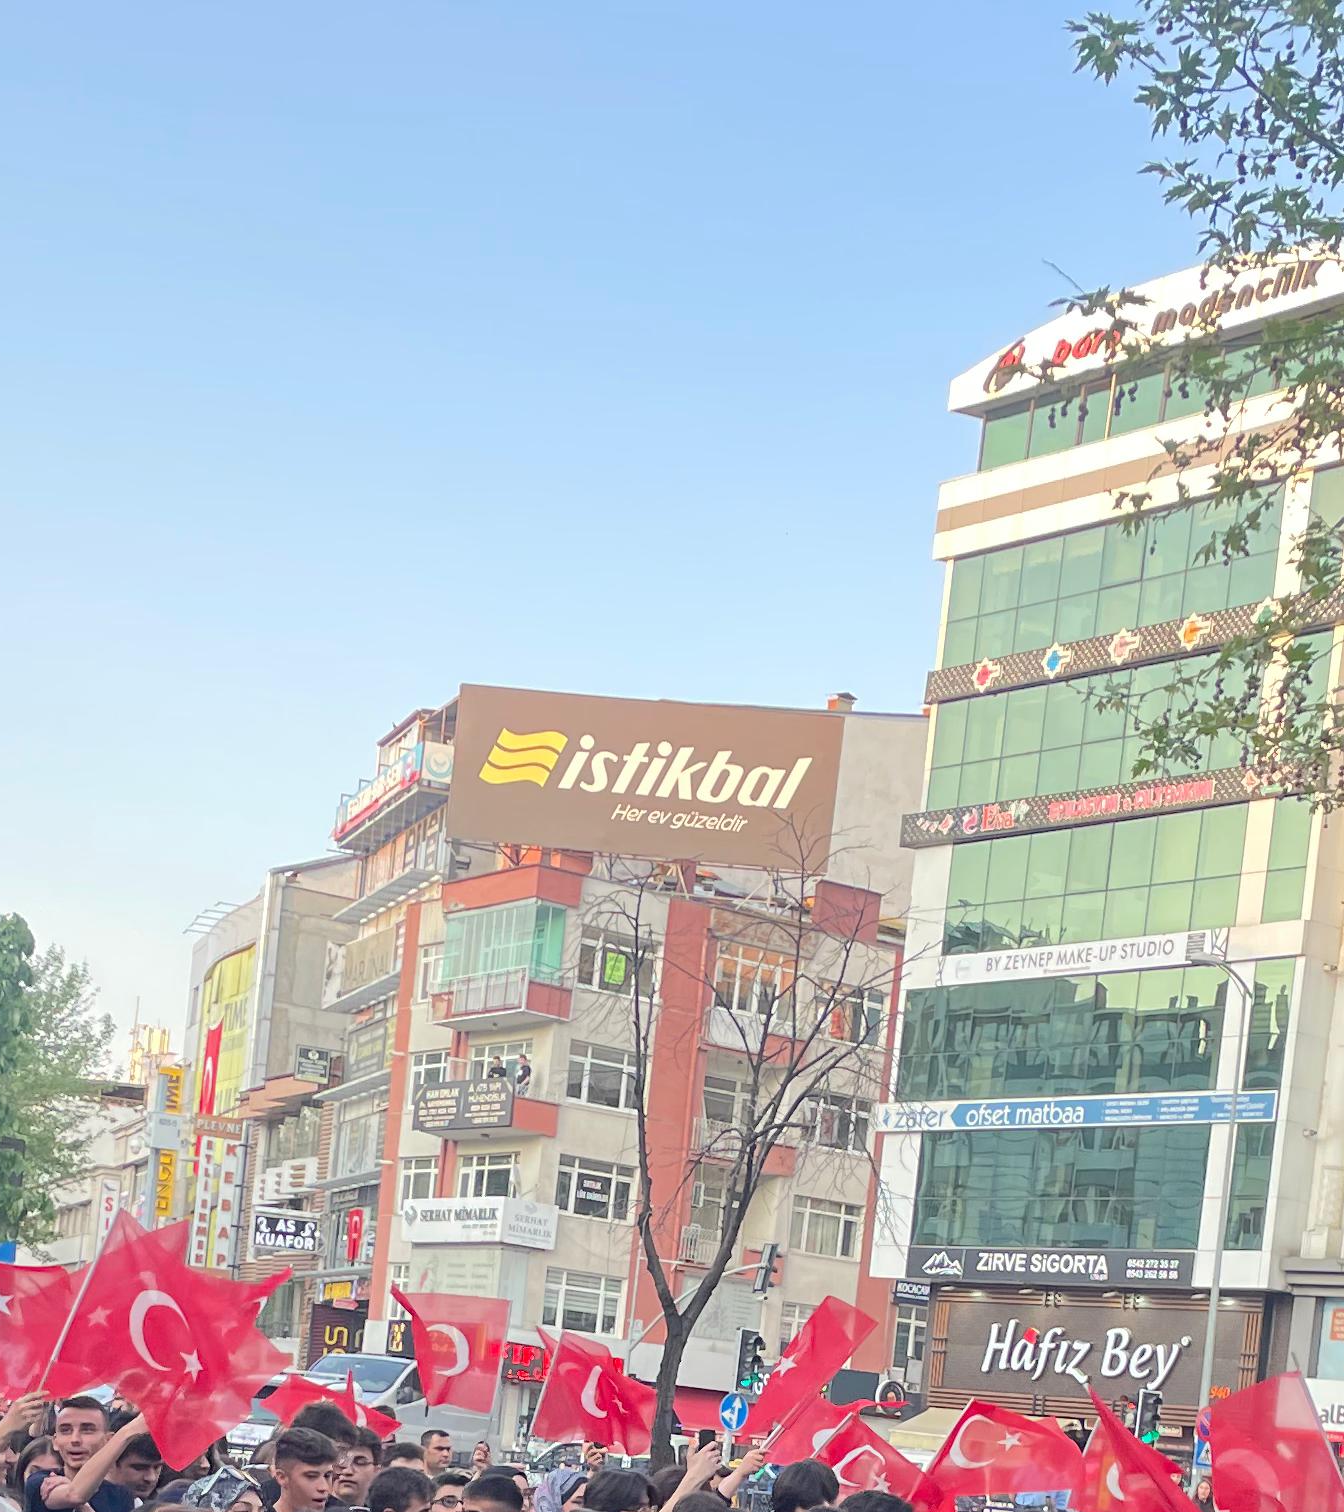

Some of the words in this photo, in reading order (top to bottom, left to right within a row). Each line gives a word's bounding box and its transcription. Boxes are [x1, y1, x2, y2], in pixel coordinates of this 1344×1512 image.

[557, 734, 813, 809] istikbal
[610, 804, 647, 822] Her
[647, 811, 673, 824] ev
[672, 810, 748, 833] güzeldir
[986, 956, 1002, 972] BY
[1005, 952, 1053, 971] ZEYNEP
[1057, 945, 1116, 965] MAKE-UP
[1120, 939, 1175, 960] STUDIO
[197, 1118, 242, 1134] PLEVNE
[894, 1108, 947, 1129] zafer
[966, 1103, 1011, 1126] ofset
[1015, 1102, 1085, 1125] matbaa
[217, 1143, 237, 1266] KEBAP
[420, 1208, 452, 1222] SERHAT
[453, 1206, 499, 1222] MİMARLIK
[508, 1222, 552, 1239] MİMARLIK
[514, 1214, 549, 1226] SERHAT
[1100, 1326, 1182, 1390] Bey
